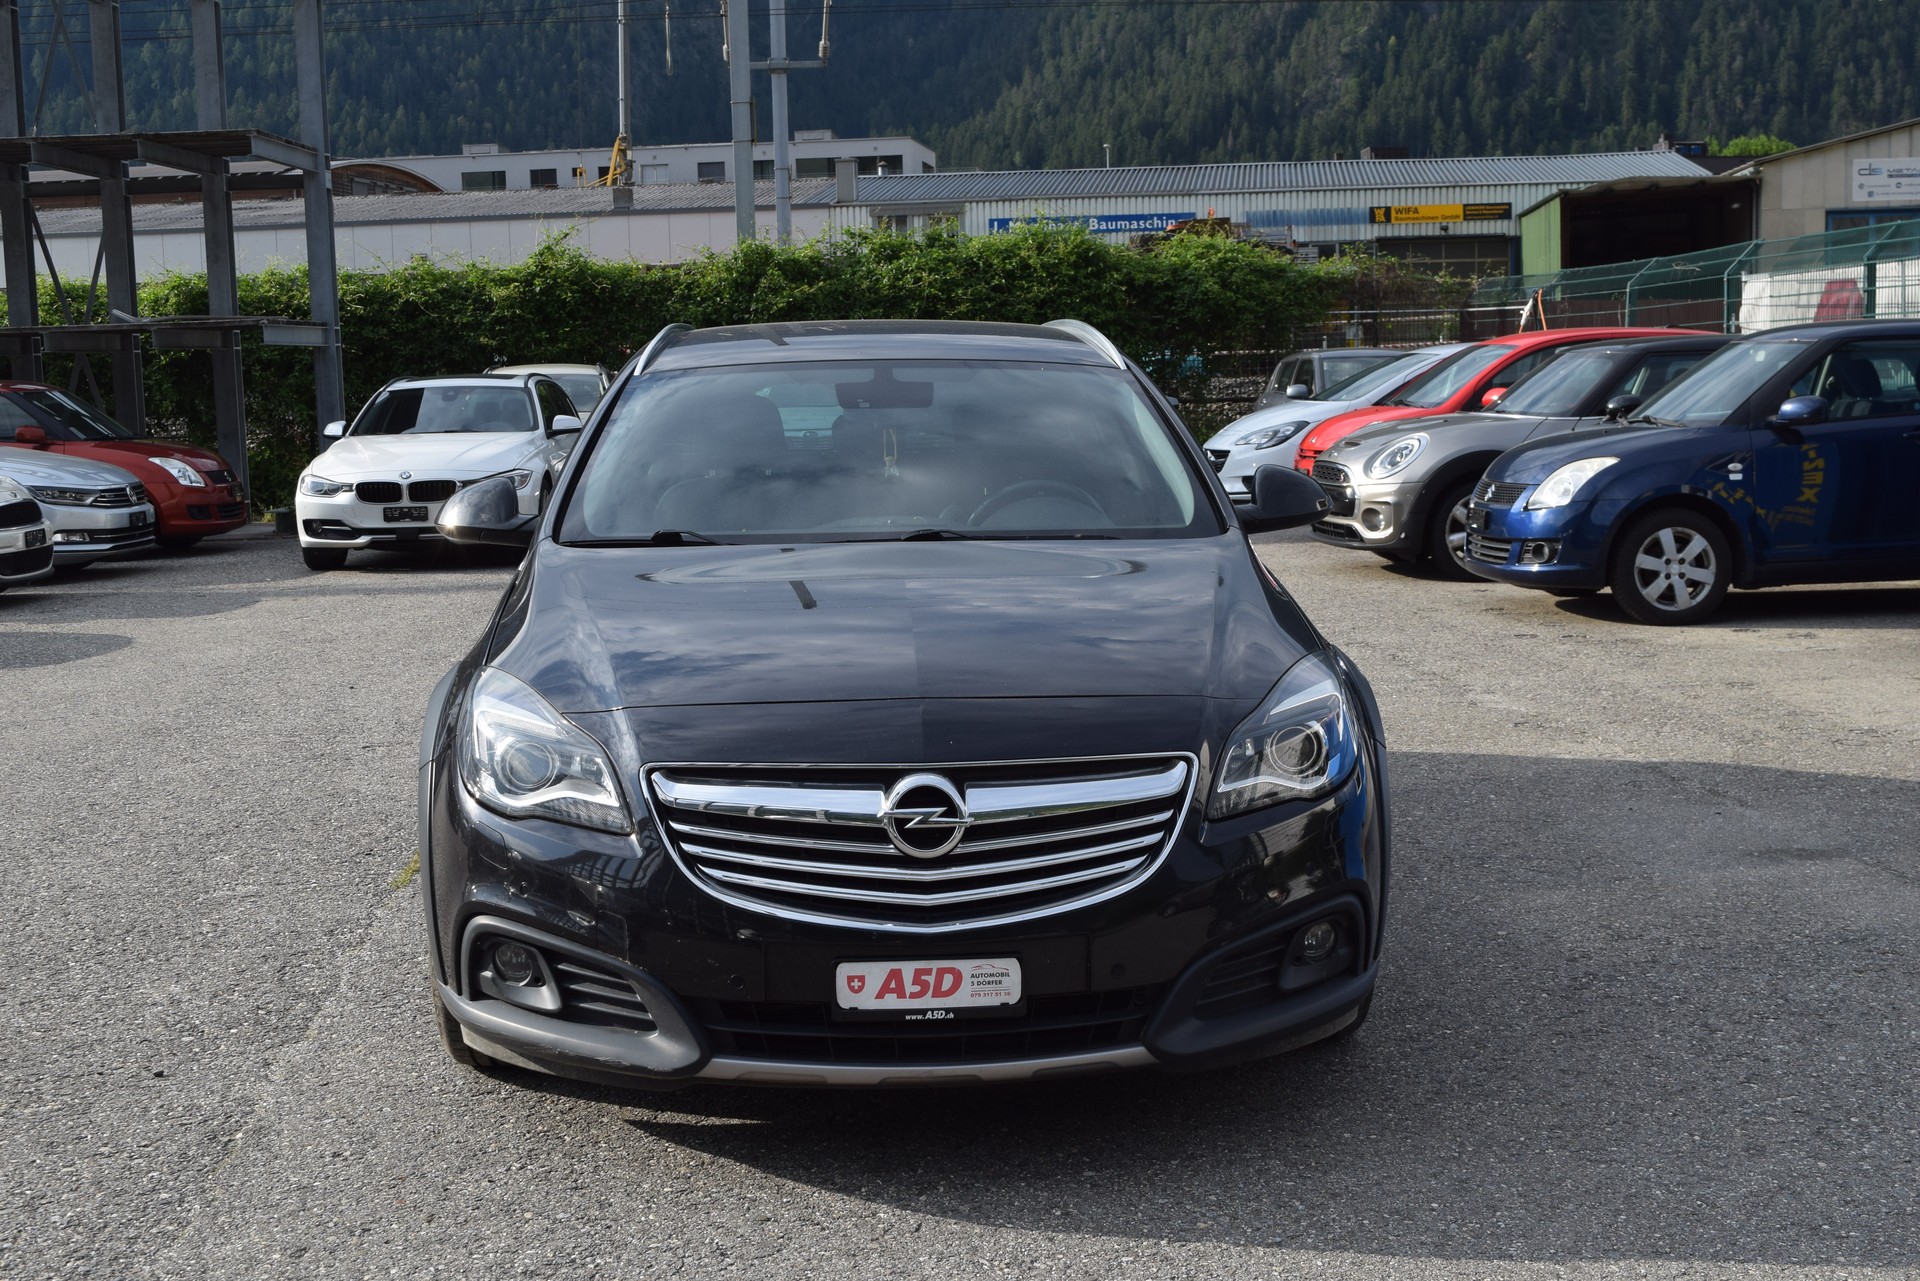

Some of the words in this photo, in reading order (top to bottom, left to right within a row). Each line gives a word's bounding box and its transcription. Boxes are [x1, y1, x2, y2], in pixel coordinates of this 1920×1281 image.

[1394, 207, 1419, 215] WIFA
[1089, 217, 1179, 230] Baumaschin
[874, 966, 963, 999] A5D
[905, 1010, 955, 1020] www.A5D.ch
